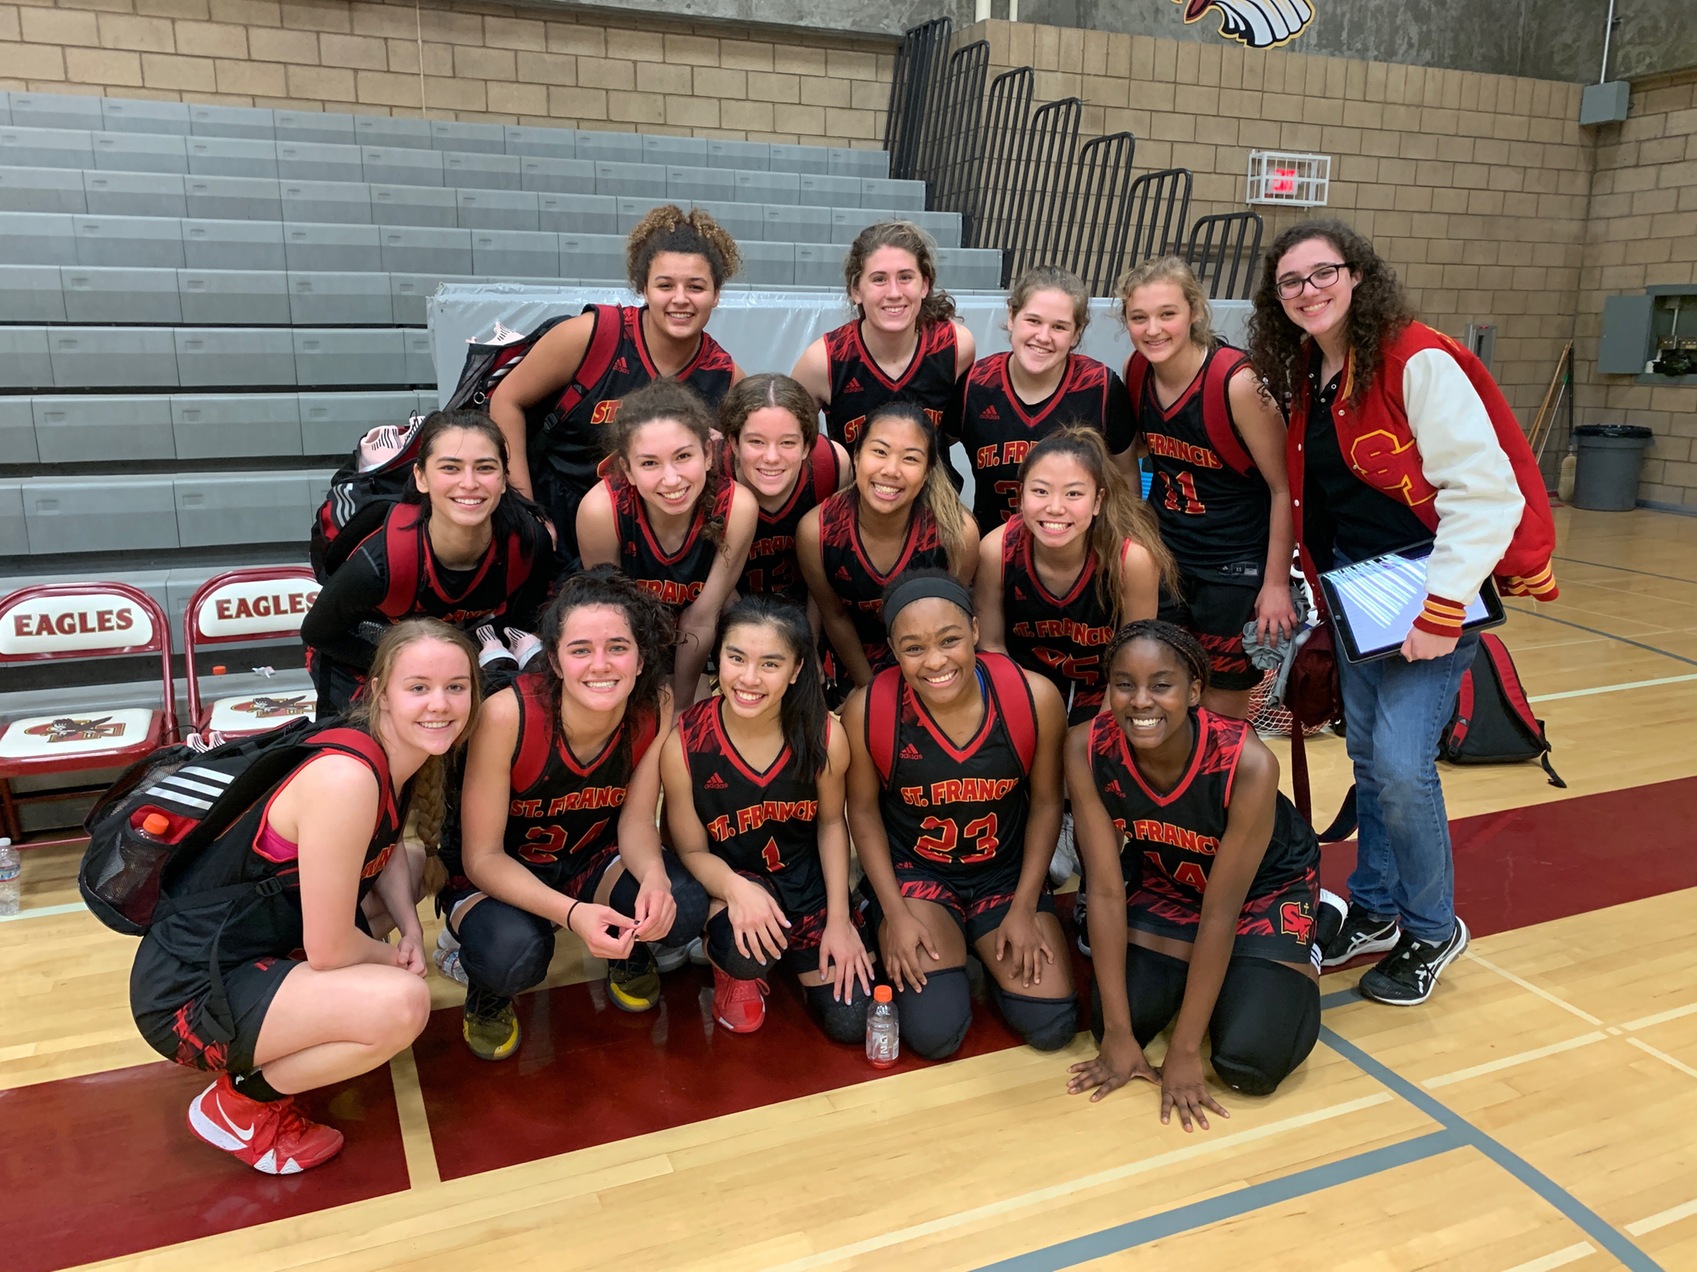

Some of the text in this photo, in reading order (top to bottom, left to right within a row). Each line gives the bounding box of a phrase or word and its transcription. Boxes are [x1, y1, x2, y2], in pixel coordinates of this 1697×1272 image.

[976, 443, 1000, 470] ST.
[1146, 432, 1223, 470] FRANCIS
[993, 480, 1023, 523] 3
[635, 579, 706, 605] FRANC
[13, 608, 134, 637] EAGLES
[1035, 618, 1115, 646] FRANCIS
[510, 785, 627, 818] ST. FRANC
[901, 785, 929, 807] ST.
[914, 811, 1000, 864] 23
